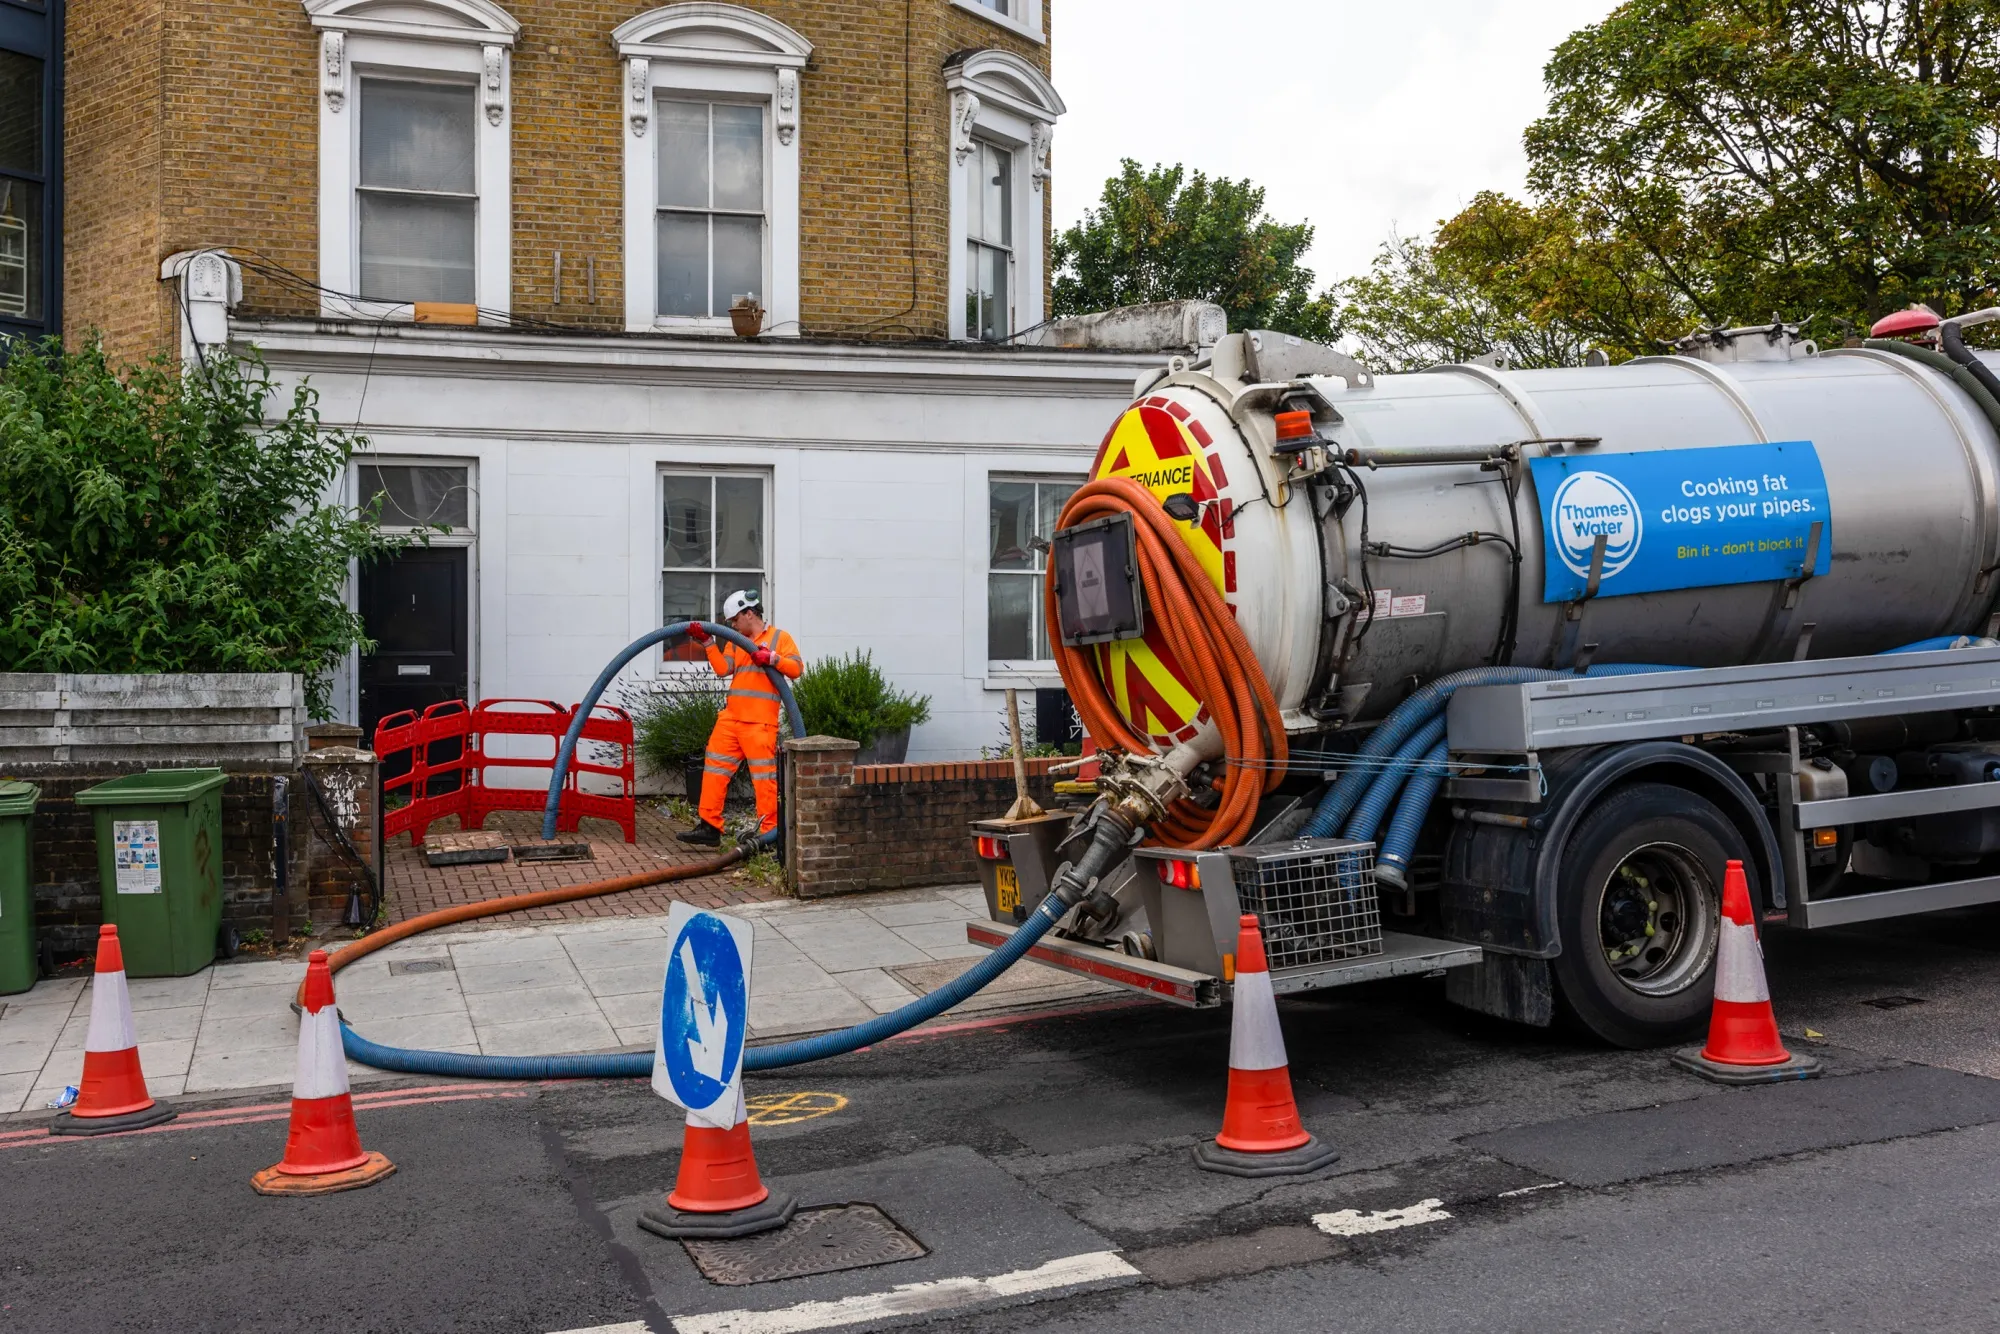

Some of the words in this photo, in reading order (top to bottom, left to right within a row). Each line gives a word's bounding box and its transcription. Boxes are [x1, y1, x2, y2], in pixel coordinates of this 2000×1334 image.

[1130, 466, 1192, 487] ENANCE
[1681, 477, 1759, 498] Cooking
[1763, 474, 1788, 491] fat
[1562, 504, 1628, 520] Thames
[1661, 505, 1711, 524] clogs
[1716, 502, 1756, 522] your
[1763, 497, 1815, 518] pipes.
[1573, 521, 1623, 537] Water
[1677, 546, 1698, 559] Bin
[1701, 544, 1710, 557] it
[1722, 540, 1755, 555] don't
[1758, 537, 1792, 552] block
[1795, 536, 1803, 549] it
